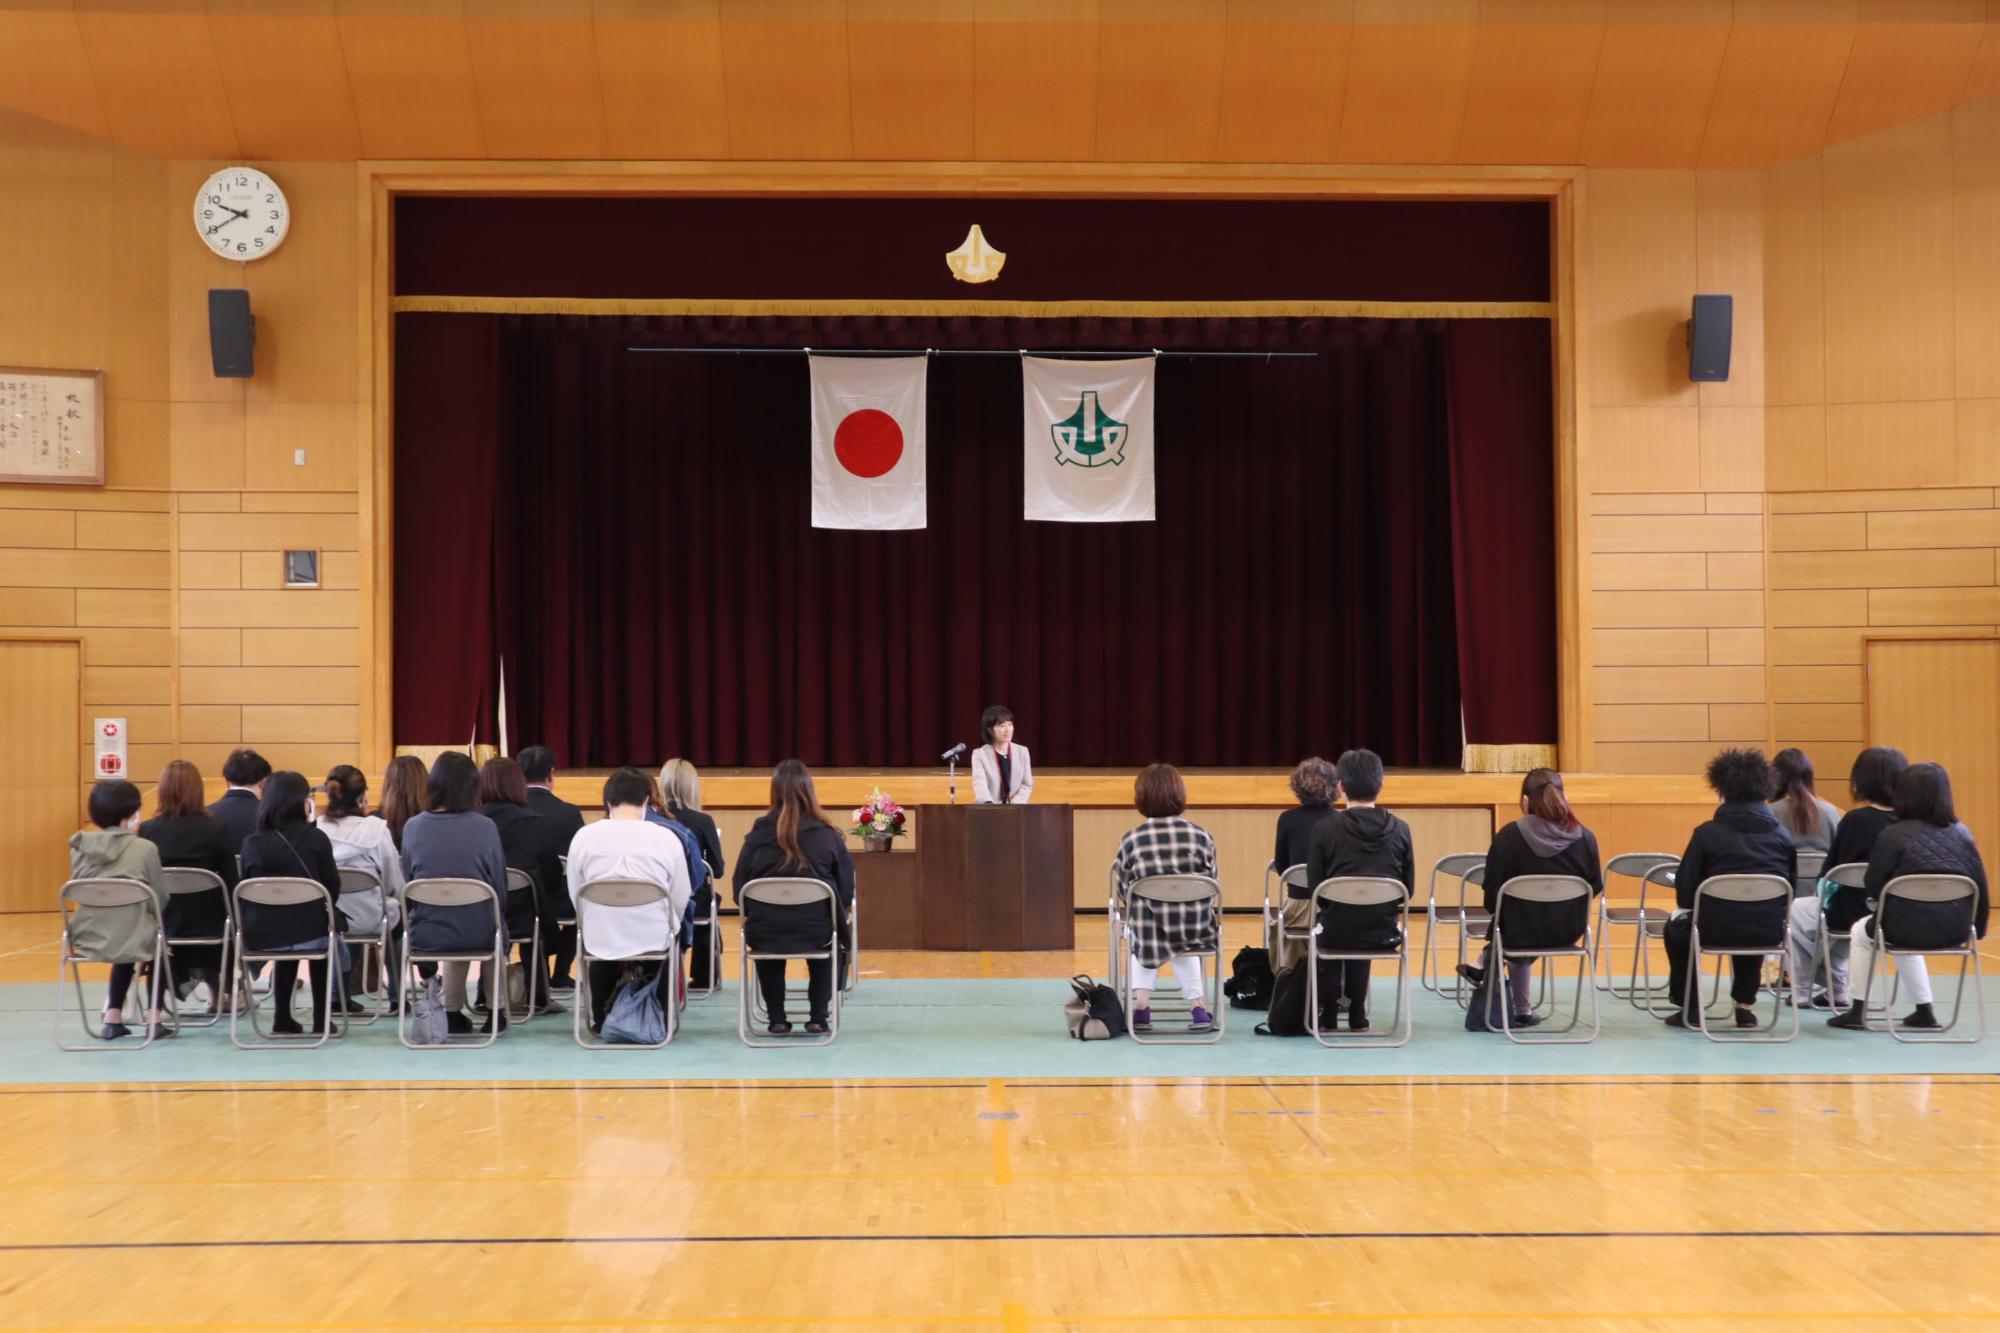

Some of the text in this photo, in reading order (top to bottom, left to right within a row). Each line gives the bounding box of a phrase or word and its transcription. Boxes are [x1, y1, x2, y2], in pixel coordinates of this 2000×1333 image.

[236, 177, 248, 186] 12
[219, 183, 230, 192] 11
[208, 195, 221, 204] 10
[266, 194, 275, 203] 2
[203, 210, 214, 219] 9
[270, 210, 280, 219] 3
[264, 225, 275, 234] 4
[221, 239, 231, 248] 7
[254, 238, 264, 247] 5
[237, 243, 247, 252] 6
